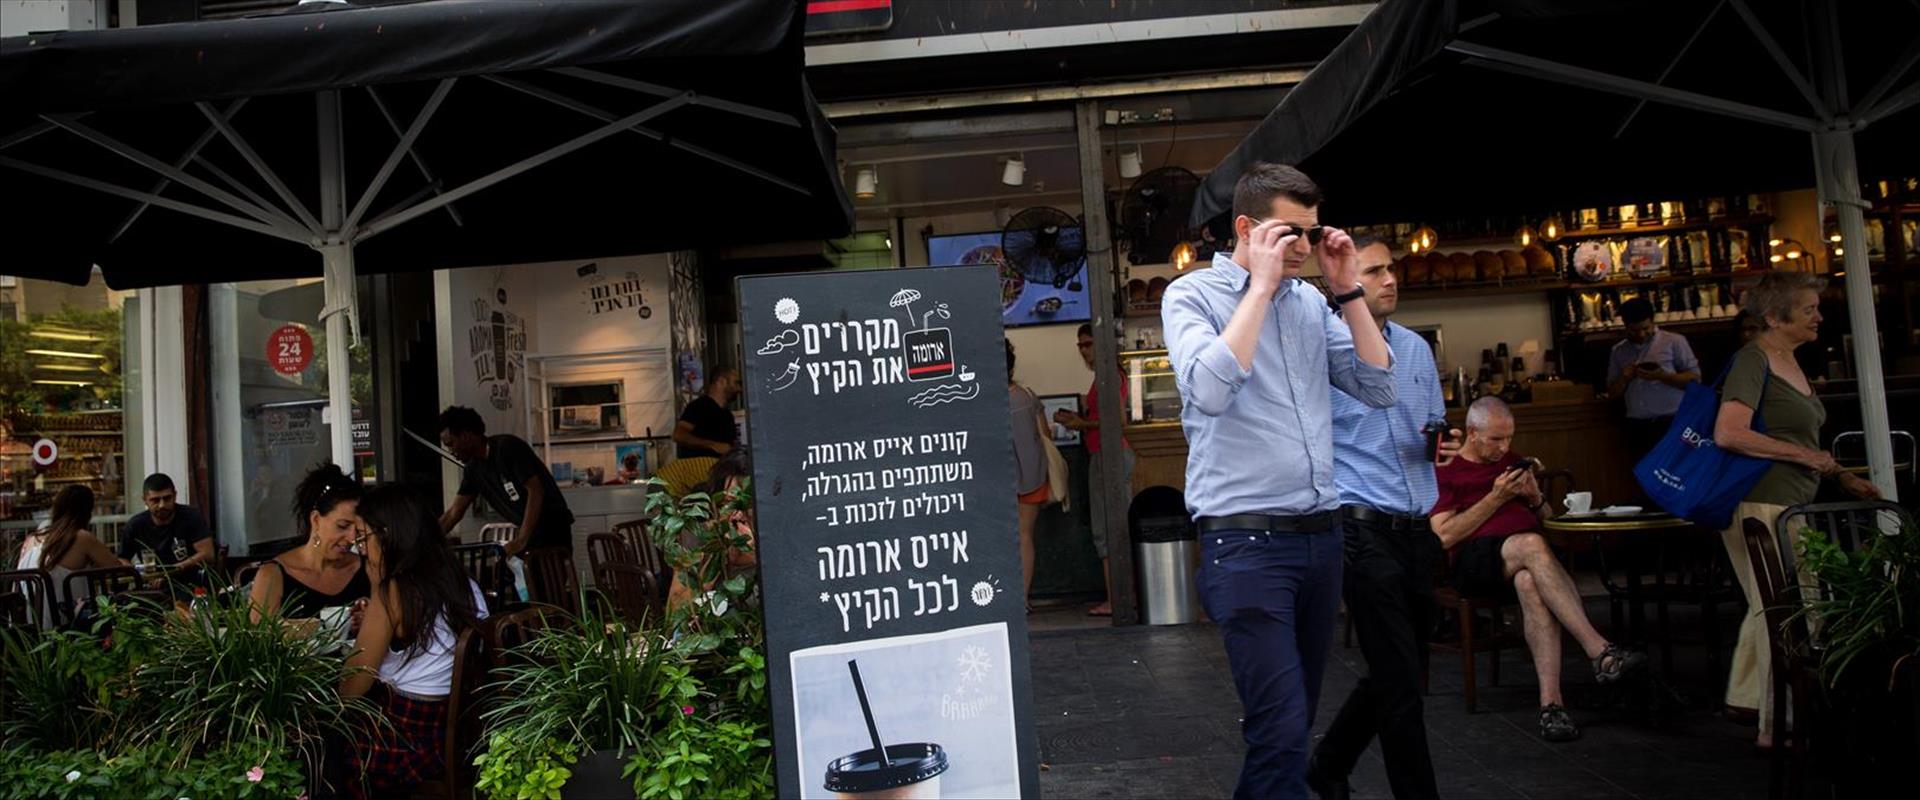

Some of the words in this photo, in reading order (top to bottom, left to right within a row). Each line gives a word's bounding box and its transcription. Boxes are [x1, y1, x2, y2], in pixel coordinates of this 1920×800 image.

[278, 342, 301, 356] 24
[802, 319, 900, 356] מקררים
[911, 343, 945, 363] ארומה
[278, 356, 303, 364] שעות
[872, 357, 904, 388] את
[806, 361, 864, 395] הקיץ
[802, 440, 867, 471] ארומה,
[873, 435, 914, 459] אייס
[920, 430, 968, 455] קונים
[802, 471, 877, 503] בהגרלה,
[882, 461, 973, 492] משתתפים
[845, 496, 896, 526] לזכות
[903, 492, 965, 519] ויכולים
[817, 538, 902, 581] ארומה
[910, 530, 969, 569] אייס
[908, 574, 959, 617] לכל
